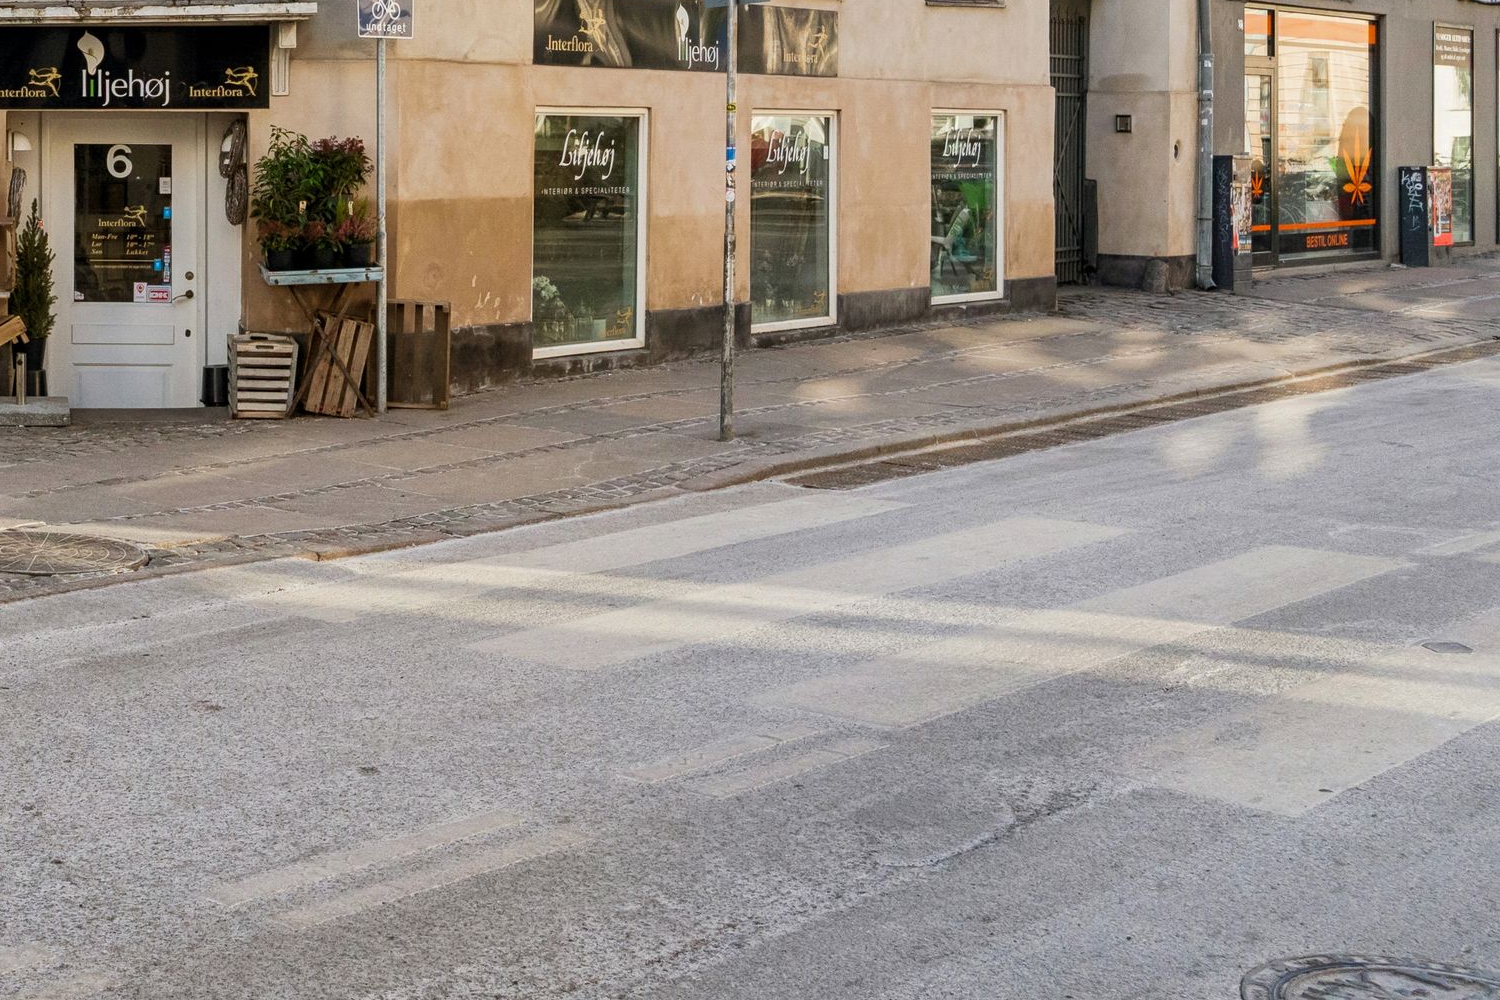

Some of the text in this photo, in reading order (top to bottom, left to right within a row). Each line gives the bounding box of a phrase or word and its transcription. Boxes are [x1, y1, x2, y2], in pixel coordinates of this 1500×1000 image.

[366, 22, 406, 34] undtaget
[546, 34, 593, 53] Interflora
[189, 86, 244, 97] Interflora
[559, 129, 616, 181] Liljehøj
[766, 129, 810, 175] Liljehøj
[942, 127, 981, 168] Liljehøj
[106, 144, 133, 179] 6
[581, 186, 630, 195] SPECIALITETER
[98, 218, 137, 228] Interflora
[1306, 233, 1348, 249] BESTIL ONLINE
